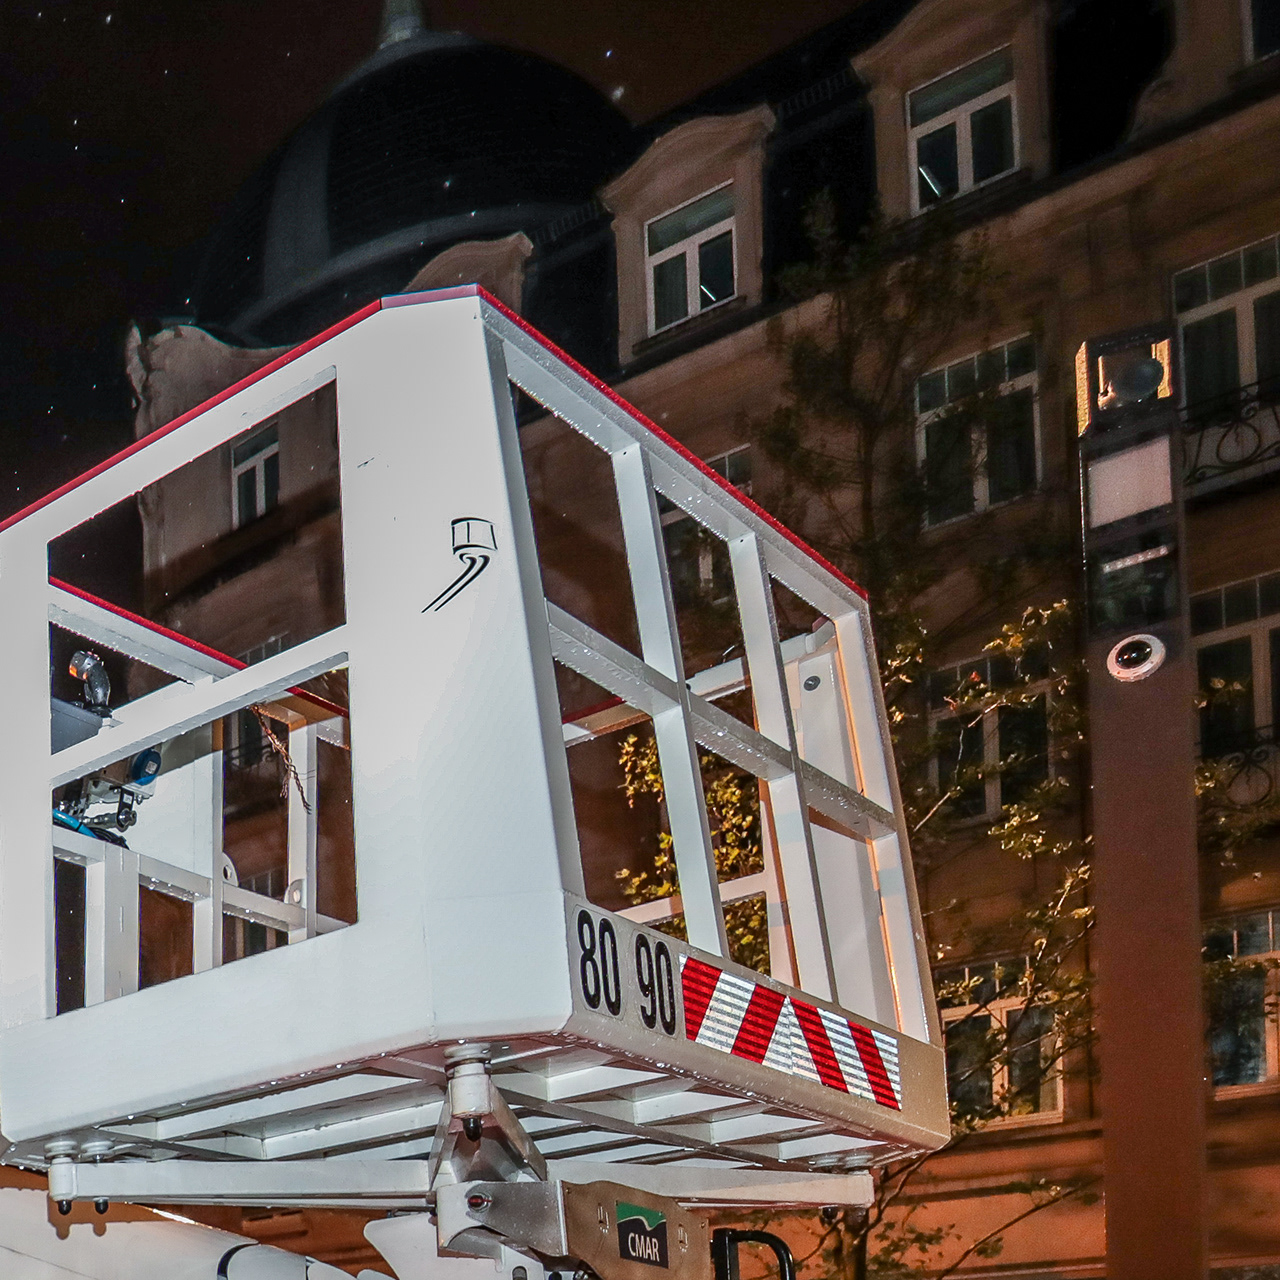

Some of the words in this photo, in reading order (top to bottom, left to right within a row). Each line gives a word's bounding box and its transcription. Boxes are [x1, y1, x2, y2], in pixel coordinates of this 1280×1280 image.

[577, 909, 620, 1016] 80
[635, 933, 676, 1036] 90
[628, 1232, 660, 1262] CMAR
